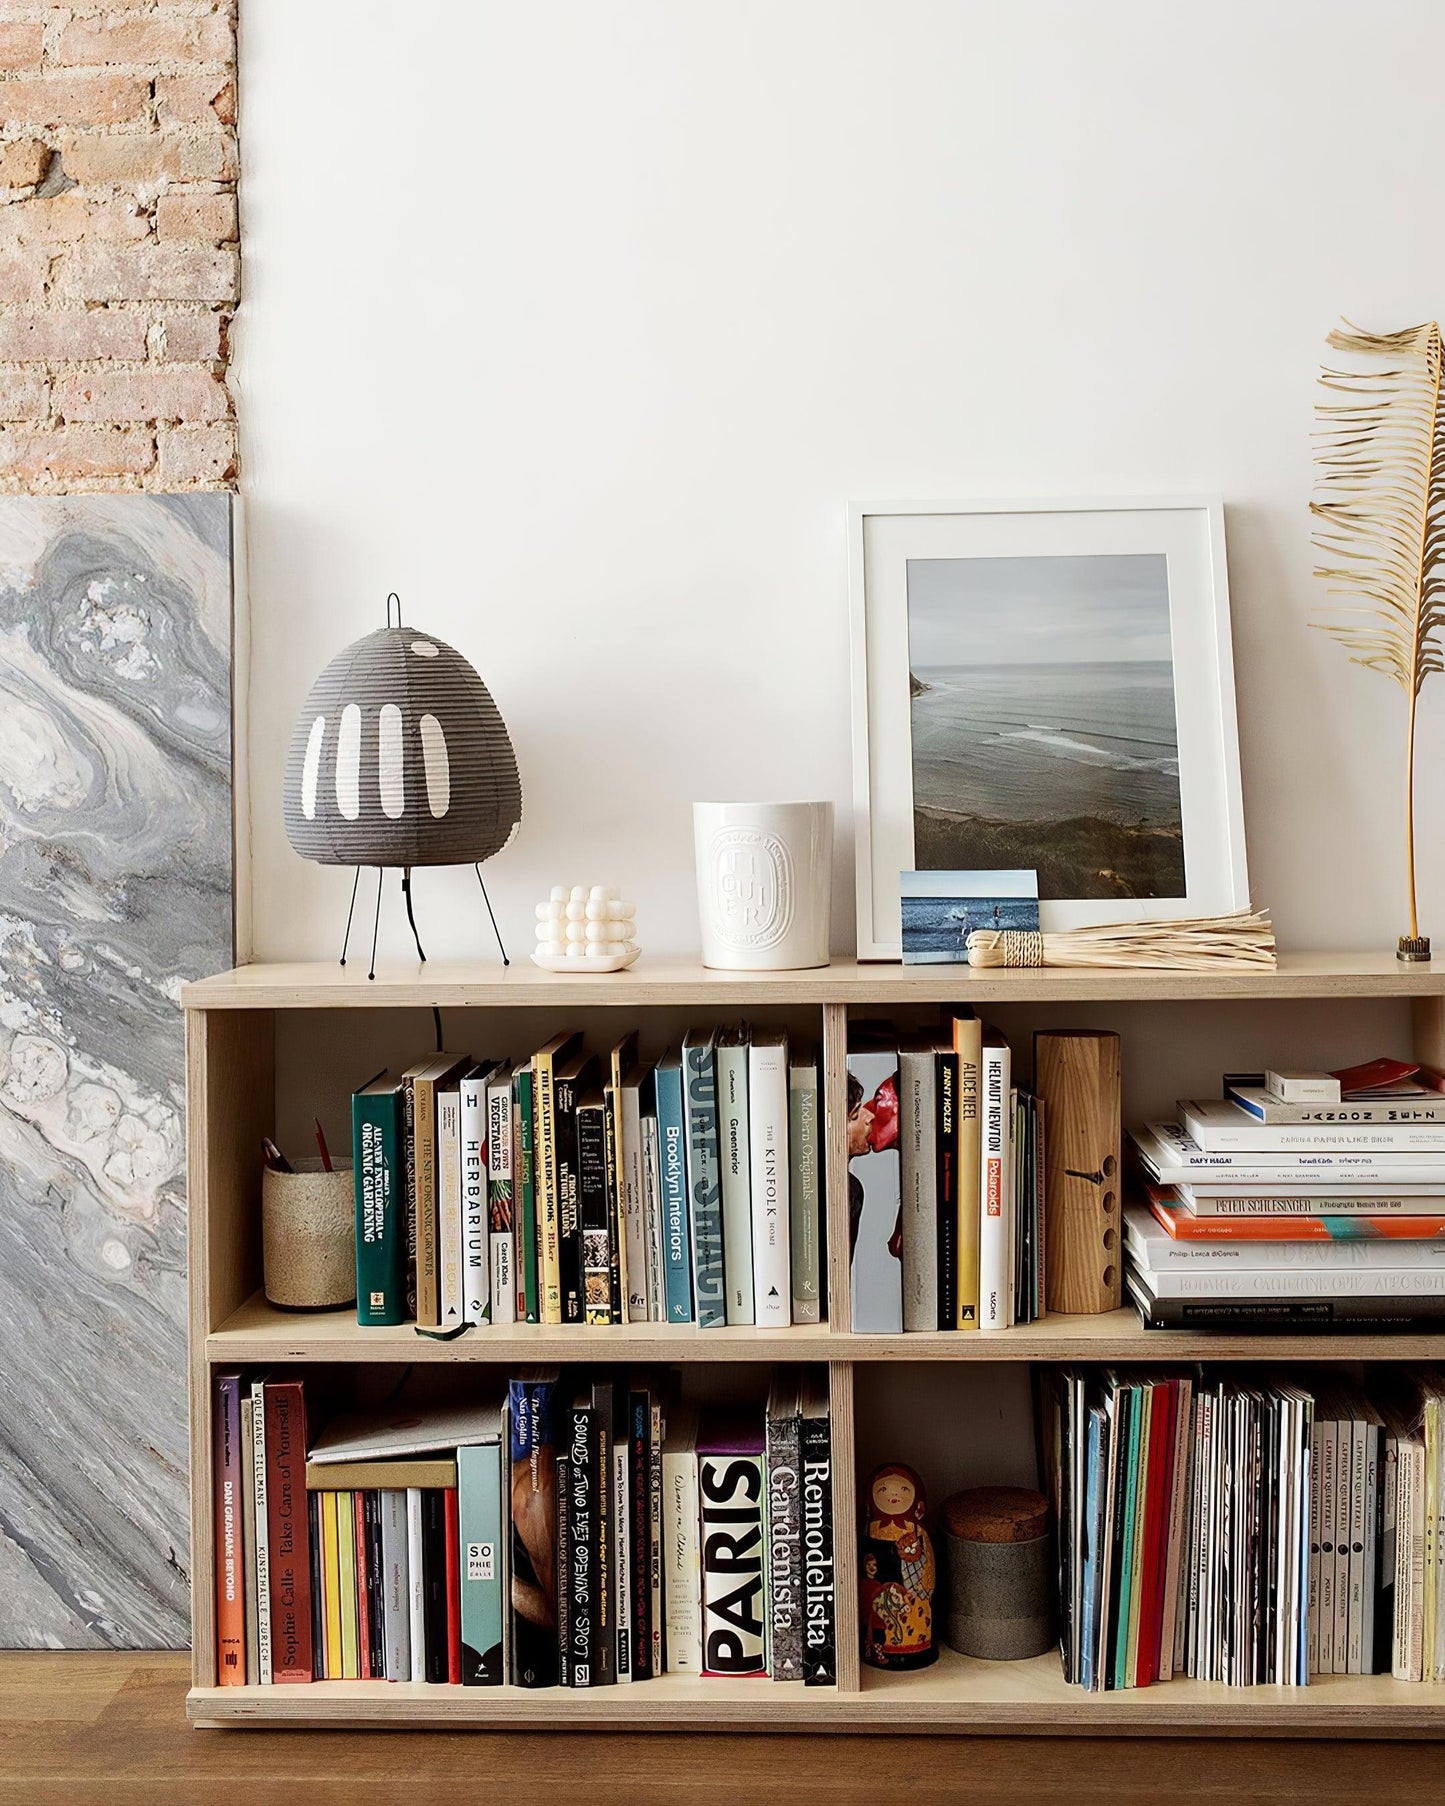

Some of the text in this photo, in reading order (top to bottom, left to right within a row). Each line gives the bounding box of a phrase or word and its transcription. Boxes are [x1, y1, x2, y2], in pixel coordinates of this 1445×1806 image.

[501, 1096, 509, 1123] GROW
[801, 1093, 813, 1141] Modern
[943, 1066, 952, 1134] JENNY HOLZER
[963, 1062, 977, 1121] ALICE NEEL
[1301, 1110, 1435, 1121] LANDON METZ
[374, 1126, 383, 1165] ALL-NEW
[423, 1138, 432, 1159] THE
[491, 1096, 501, 1171] VEGETABLES
[501, 1124, 509, 1148] YOUR
[541, 1068, 554, 1222] THE HEALTHY GARDEN BOOK
[729, 1118, 740, 1175] Greenterior
[987, 1061, 1002, 1215] HELMUT NEWTON Polaroids
[362, 1123, 375, 1242] ORGANIC GARDENING
[423, 1160, 432, 1184] NEW
[665, 1126, 684, 1261] Brooklyn Interiors
[689, 1047, 725, 1328] SURF SHACK
[766, 1148, 776, 1217] KINFOLK
[799, 1144, 814, 1201] Originals
[375, 1166, 384, 1232] ENCYCLOPEDIA
[424, 1185, 433, 1231] ORGANIC
[467, 1140, 482, 1268] HERBARIUM
[561, 1162, 571, 1239] VICTORY GARDEN
[1215, 1199, 1312, 1213] PETER SCHLESINGER
[424, 1233, 434, 1276] GROWER
[501, 1242, 509, 1264] Carol
[518, 1397, 528, 1446] Nan Goldin
[529, 1397, 541, 1493] The Devil's Playground
[571, 1414, 589, 1465] SOUNDS
[254, 1392, 264, 1507] WOLFGANG TILLMANS
[275, 1397, 293, 1557] Take Care of Yourself
[573, 1474, 589, 1507] TWO
[618, 1481, 624, 1490] To
[559, 1497, 568, 1514] THE
[571, 1511, 589, 1542] EYES
[1324, 1481, 1332, 1530] QUARTERLY
[1354, 1482, 1362, 1530] QUARTERLY
[223, 1481, 234, 1601] DAN GRAHAM: BEYOND
[470, 1546, 491, 1557] SO
[559, 1515, 568, 1548] BALLAD
[559, 1549, 568, 1562] OF
[770, 1466, 801, 1631] Gardenista
[804, 1459, 833, 1649] Remodelista
[258, 1546, 267, 1613] KUNSTHALLE
[560, 1564, 568, 1596] SEXUAL
[700, 1458, 764, 1674] PARIS
[280, 1568, 299, 1666] Sophie Calle
[560, 1597, 569, 1654] DEPENDENCY
[574, 1616, 590, 1659] SPOT
[618, 1615, 626, 1627] July
